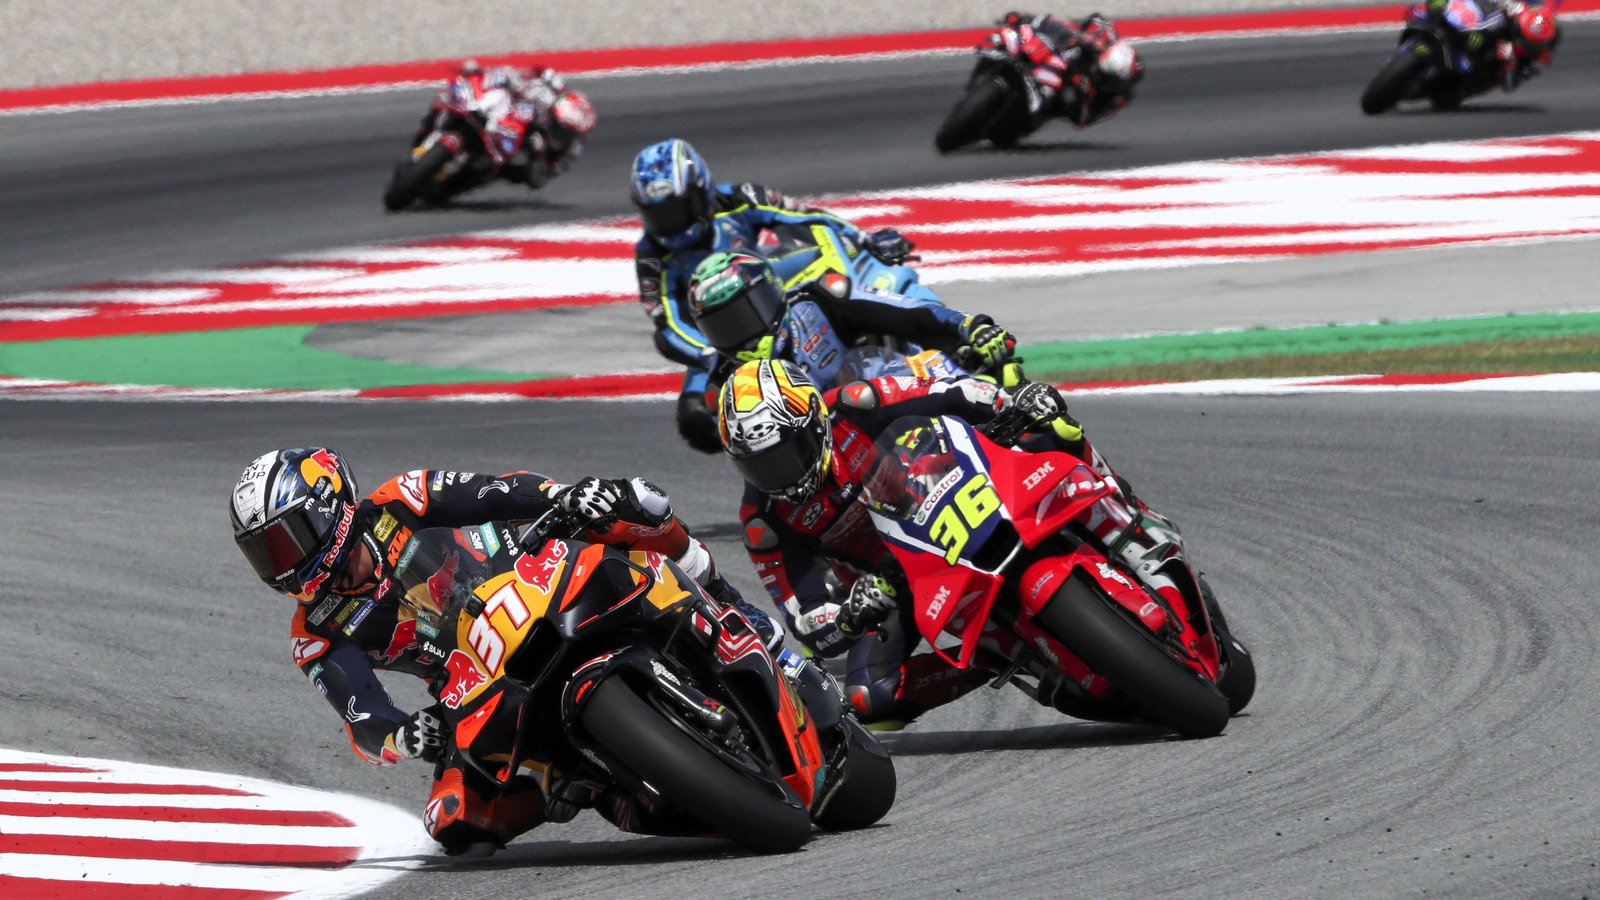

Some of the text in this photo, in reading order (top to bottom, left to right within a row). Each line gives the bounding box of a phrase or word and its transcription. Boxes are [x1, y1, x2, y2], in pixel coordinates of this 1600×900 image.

[924, 467, 965, 511] Castrol
[1022, 461, 1055, 490] IBM
[928, 472, 1001, 566] 36
[387, 525, 413, 568] KTM
[925, 585, 952, 621] IBM
[466, 579, 531, 678] 37
